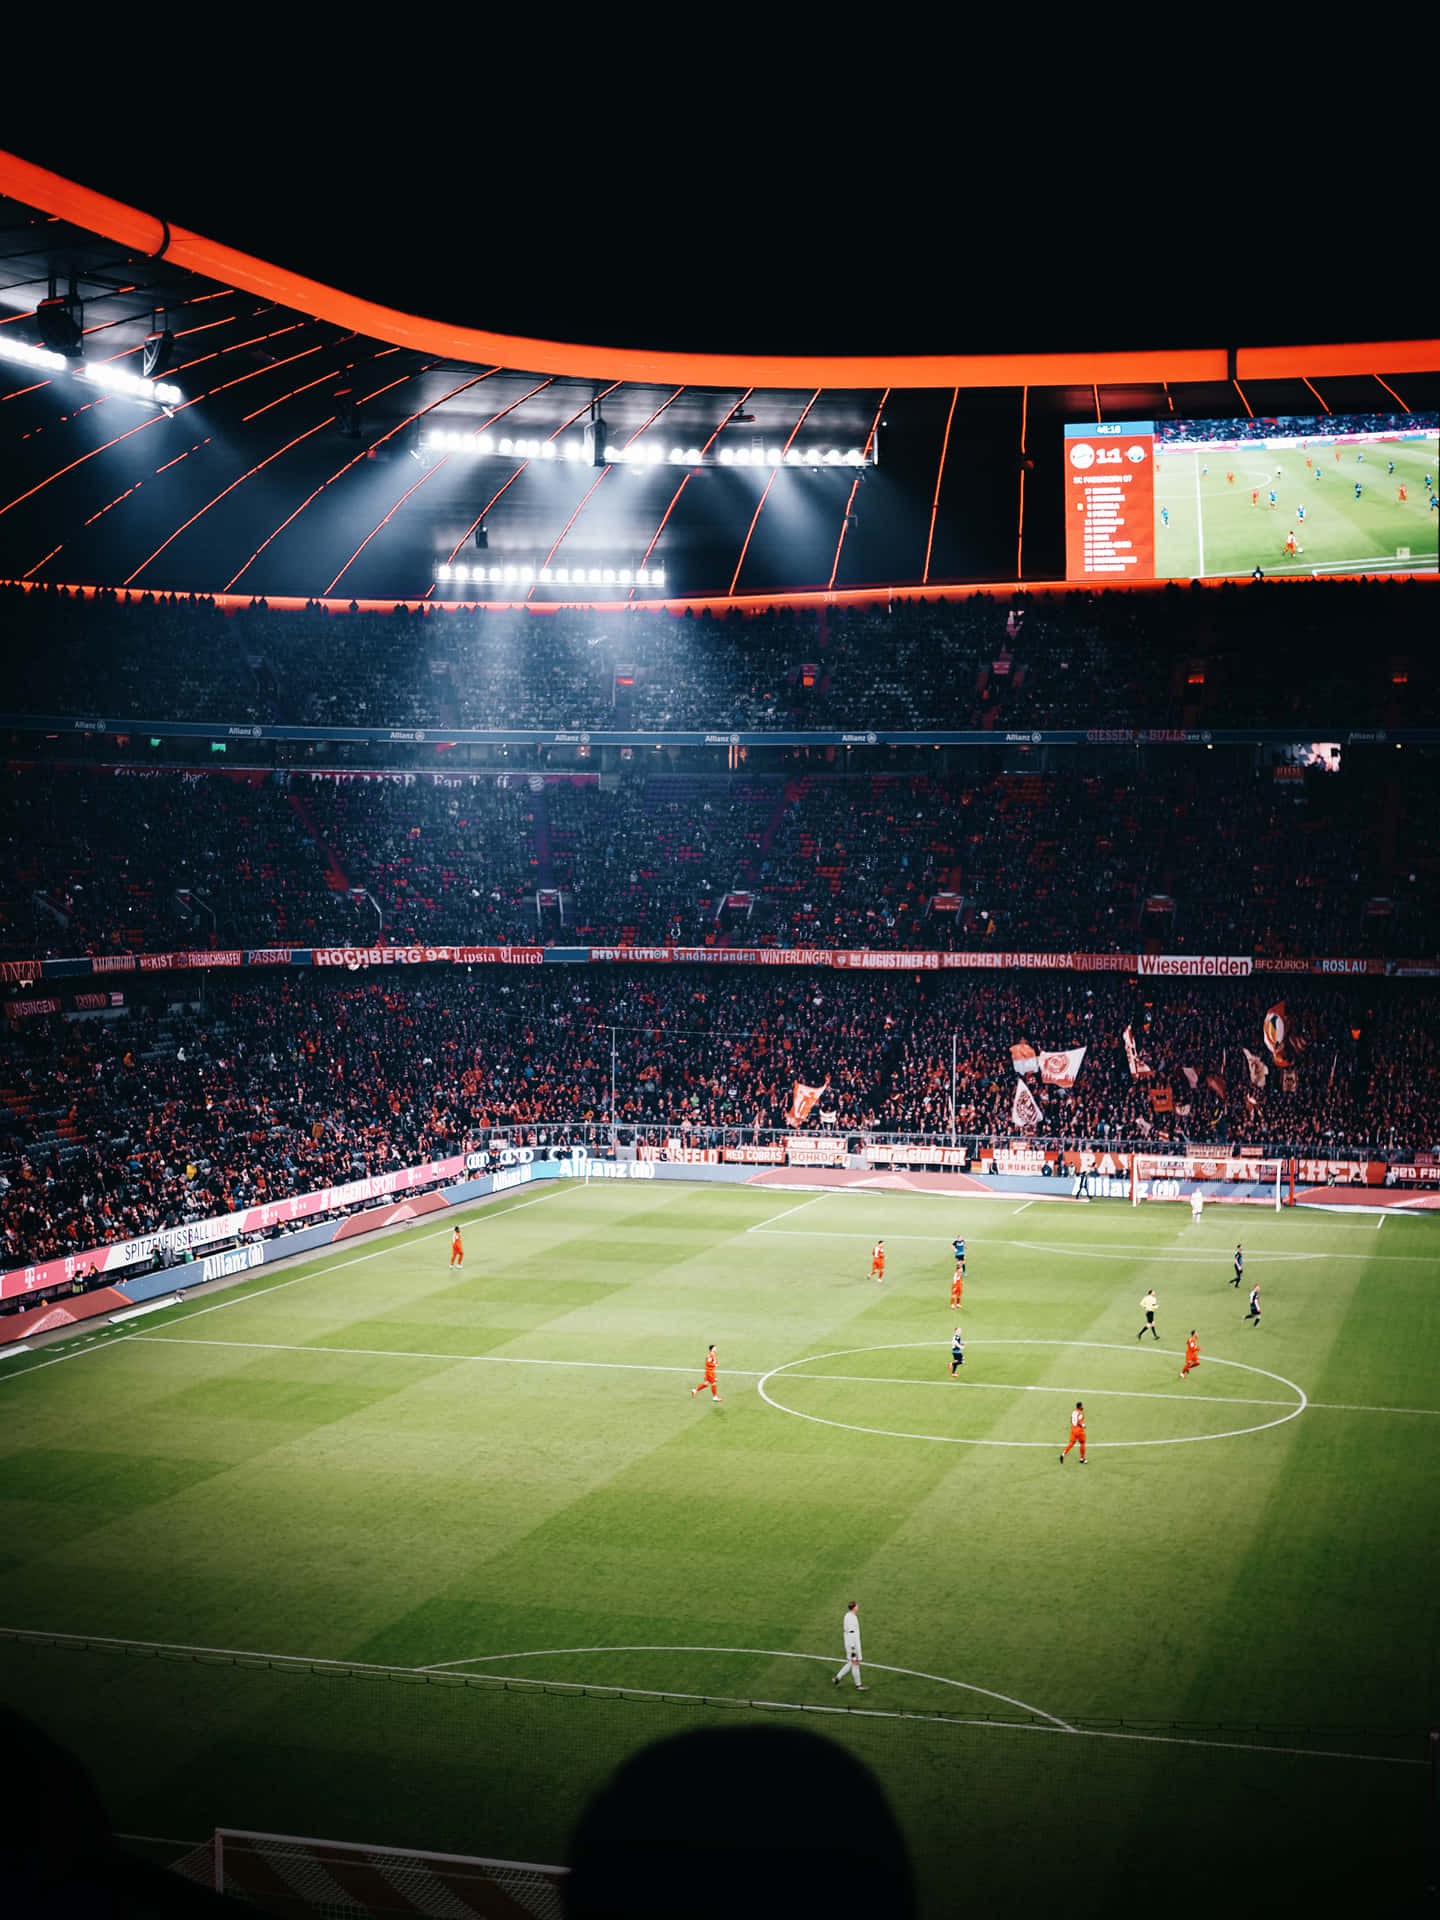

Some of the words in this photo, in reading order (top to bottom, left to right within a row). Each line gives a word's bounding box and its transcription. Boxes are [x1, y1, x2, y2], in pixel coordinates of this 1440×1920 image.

[74, 720, 97, 730] Allianz
[228, 727, 251, 736] Allianz
[390, 732, 414, 740] Allianz
[555, 734, 579, 742] Allianz
[705, 735, 729, 743] Allianz
[841, 734, 866, 742] Allianz
[1005, 733, 1030, 741] Allianz
[151, 954, 174, 969] KIST
[248, 951, 291, 963] PASSAU
[316, 949, 420, 966] HÖCHBERG
[500, 948, 543, 965] United
[672, 949, 756, 962] Sandharlanden
[759, 950, 833, 964] WINTERLINGEN
[862, 953, 923, 968] AUGUSTINER
[943, 952, 1001, 967] MEUCHEN
[1076, 956, 1137, 970] TAUBERTAL
[1141, 956, 1249, 975] Wiesenfelden
[640, 1147, 718, 1164] WENSFELD
[725, 1149, 744, 1160] RED
[559, 1159, 626, 1177] Allianz
[211, 1220, 229, 1237] LIVE
[202, 1251, 247, 1282] Allianz
